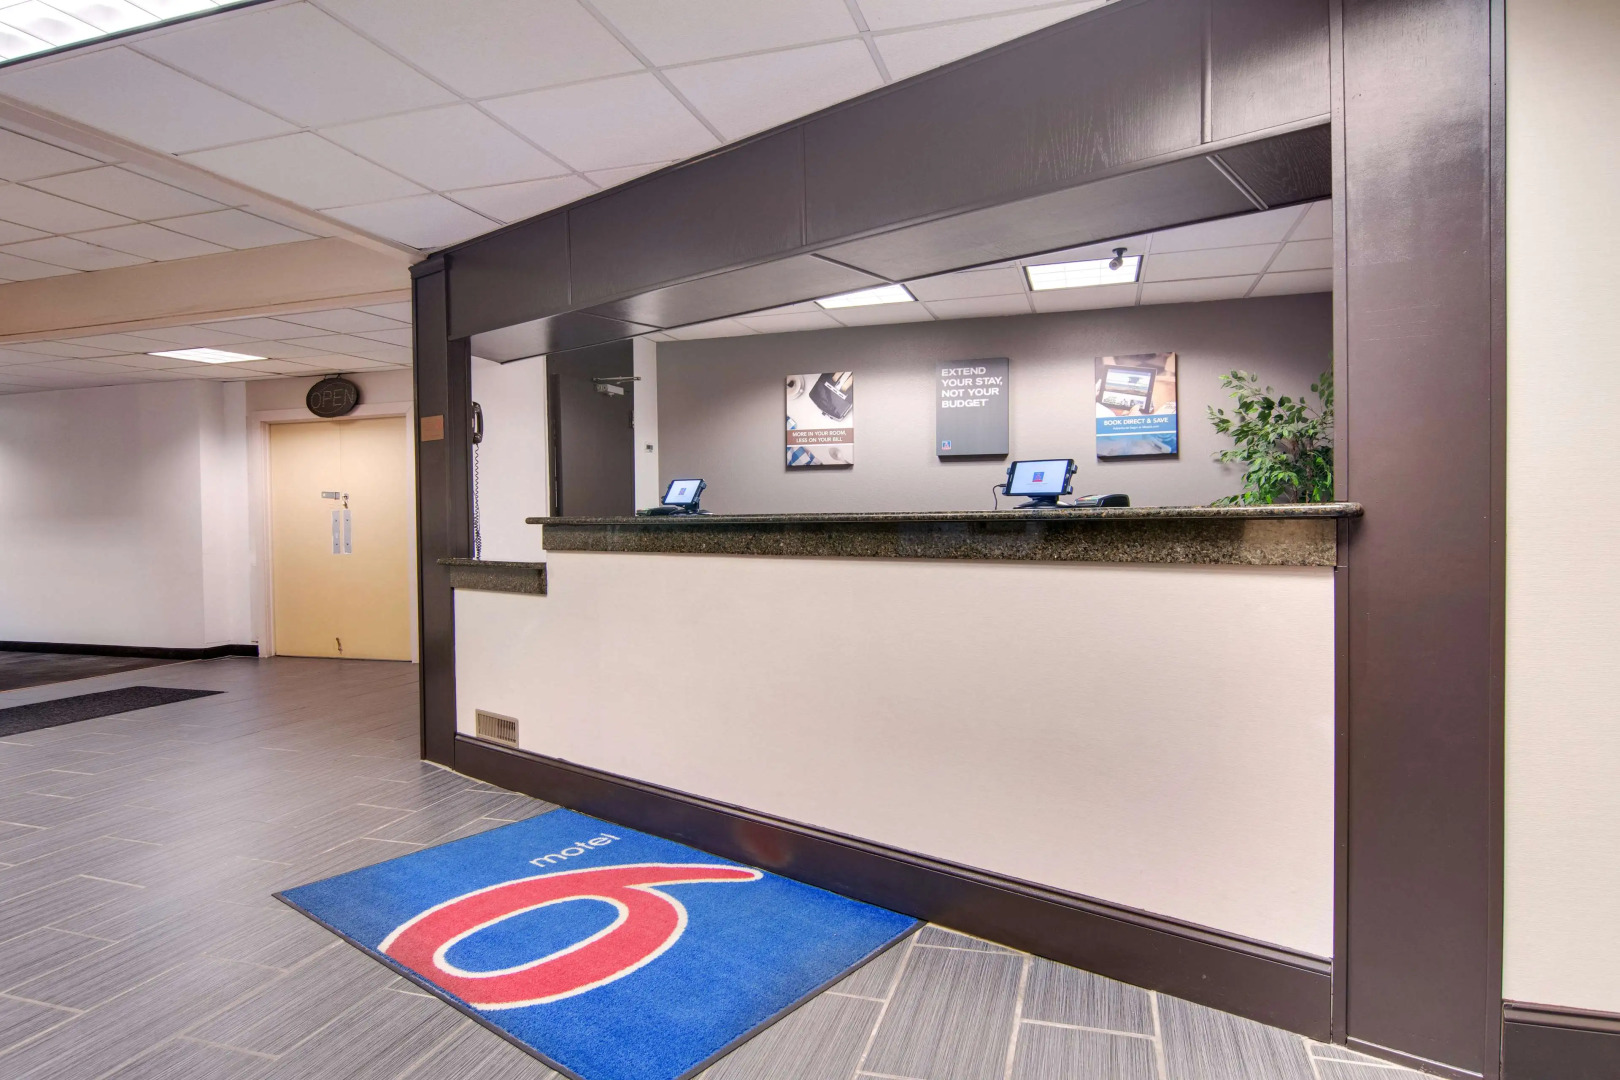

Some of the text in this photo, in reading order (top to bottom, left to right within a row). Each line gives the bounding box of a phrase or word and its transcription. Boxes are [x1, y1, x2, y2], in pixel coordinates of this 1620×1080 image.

[941, 367, 986, 376] EXTEND
[941, 376, 1003, 387] YOUR STAY,
[310, 388, 354, 408] OPEN
[941, 387, 999, 398] NOT YOUR
[941, 399, 989, 408] BUDGET
[529, 833, 621, 868] motel
[377, 862, 763, 1010] 6
